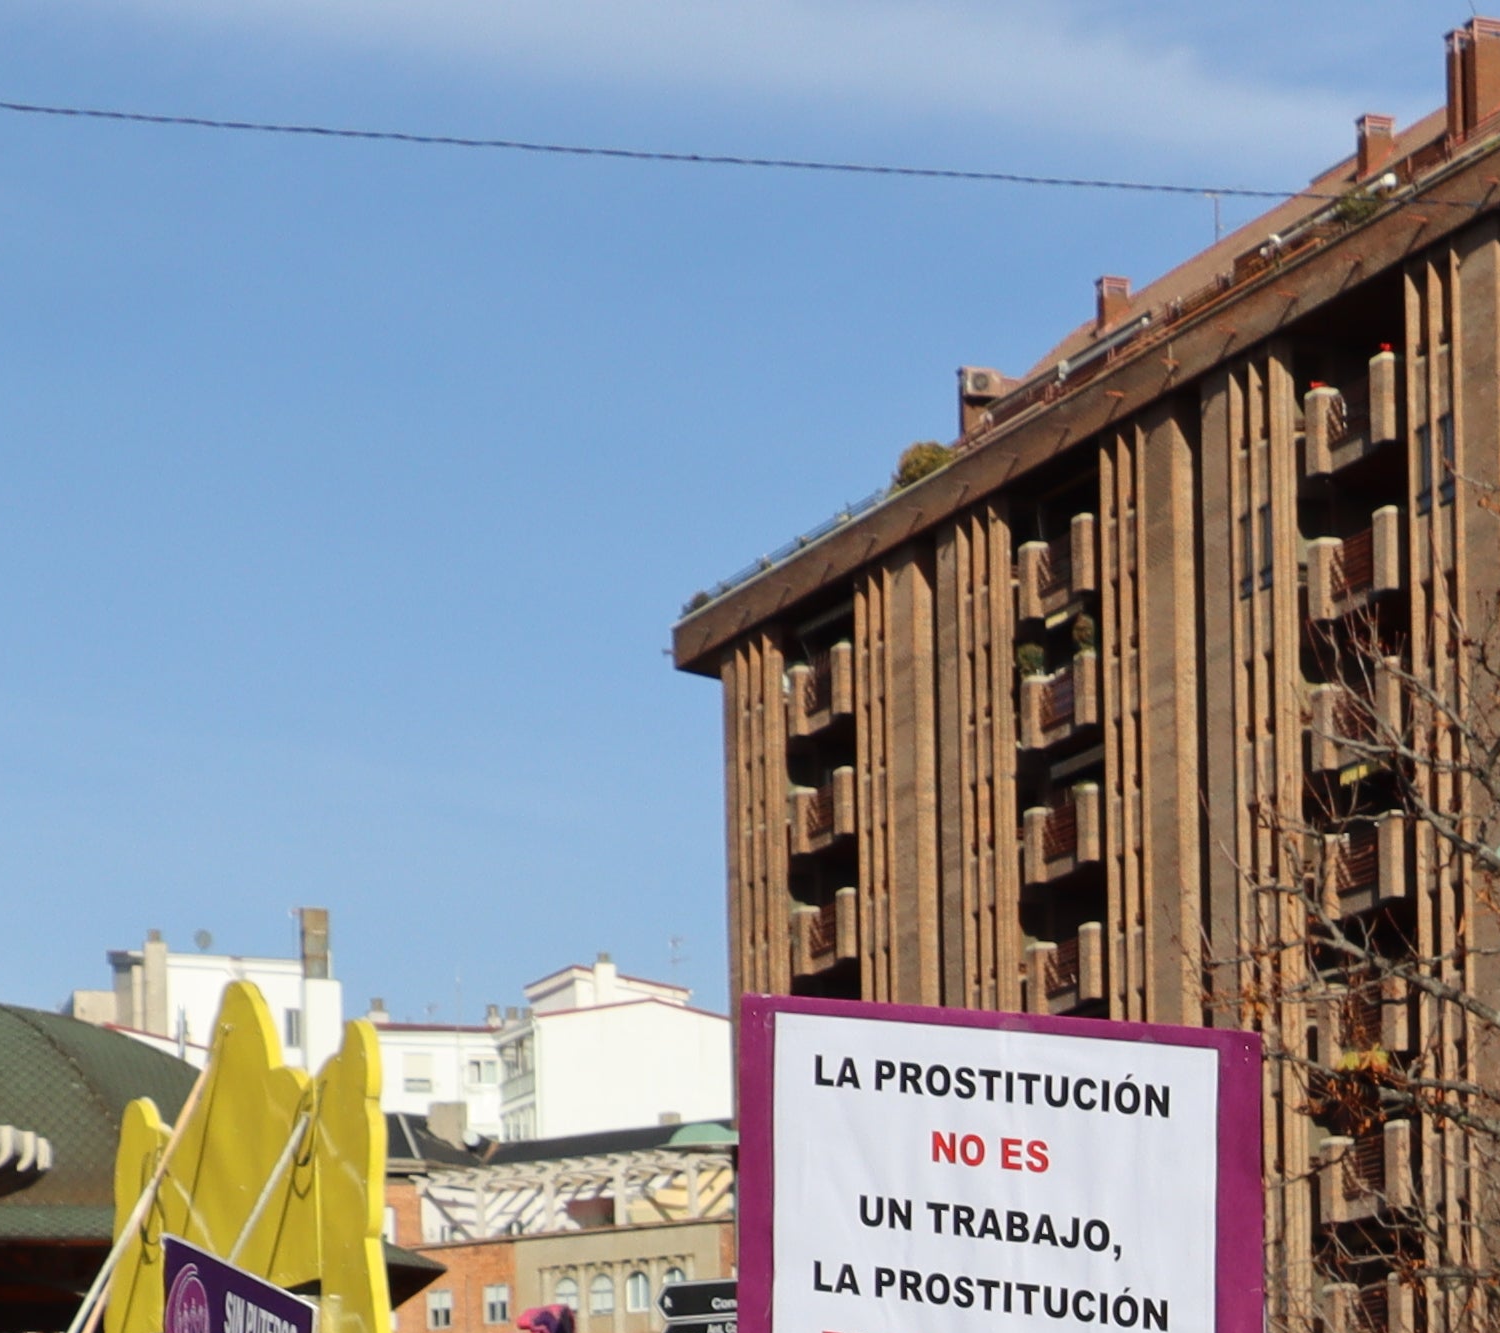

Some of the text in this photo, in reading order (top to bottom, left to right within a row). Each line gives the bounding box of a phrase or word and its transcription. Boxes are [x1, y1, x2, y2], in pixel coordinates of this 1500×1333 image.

[814, 1054, 1170, 1118] LA PROSTITUCIÓN
[931, 1130, 1050, 1173] NO ES
[859, 1194, 1122, 1260] UN TRABAJO,
[813, 1260, 1169, 1332] LA PROSTITUCIÓN
